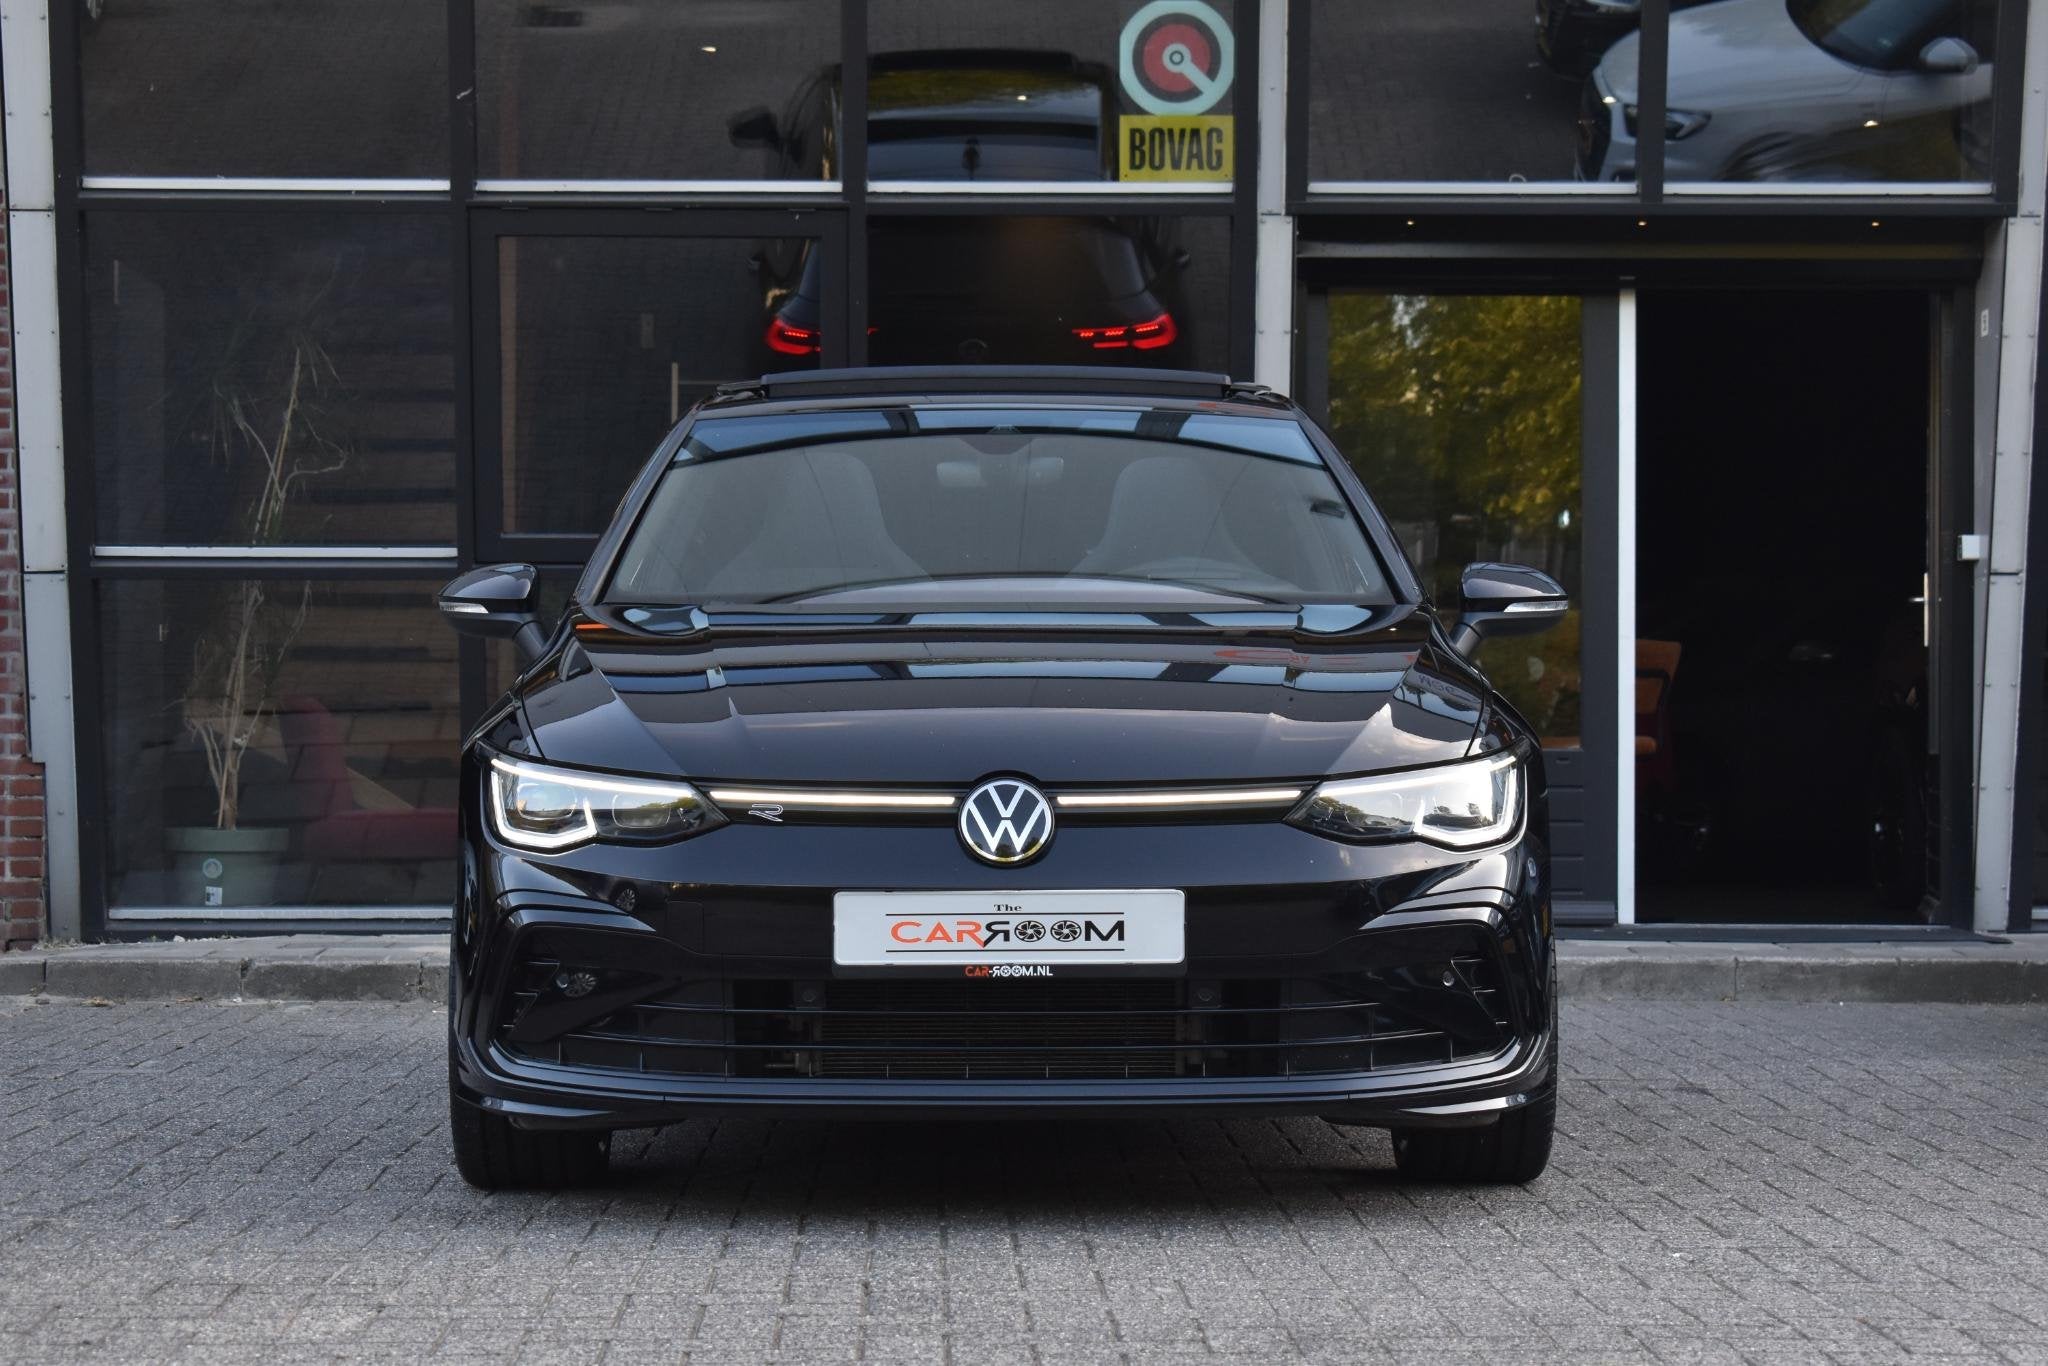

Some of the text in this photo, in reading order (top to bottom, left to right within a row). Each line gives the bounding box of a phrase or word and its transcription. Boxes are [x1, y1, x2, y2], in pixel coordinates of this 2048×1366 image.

[1129, 127, 1224, 171] BOVAG
[993, 902, 1023, 913] The
[964, 964, 1054, 978] CAR-ROOM.NL
